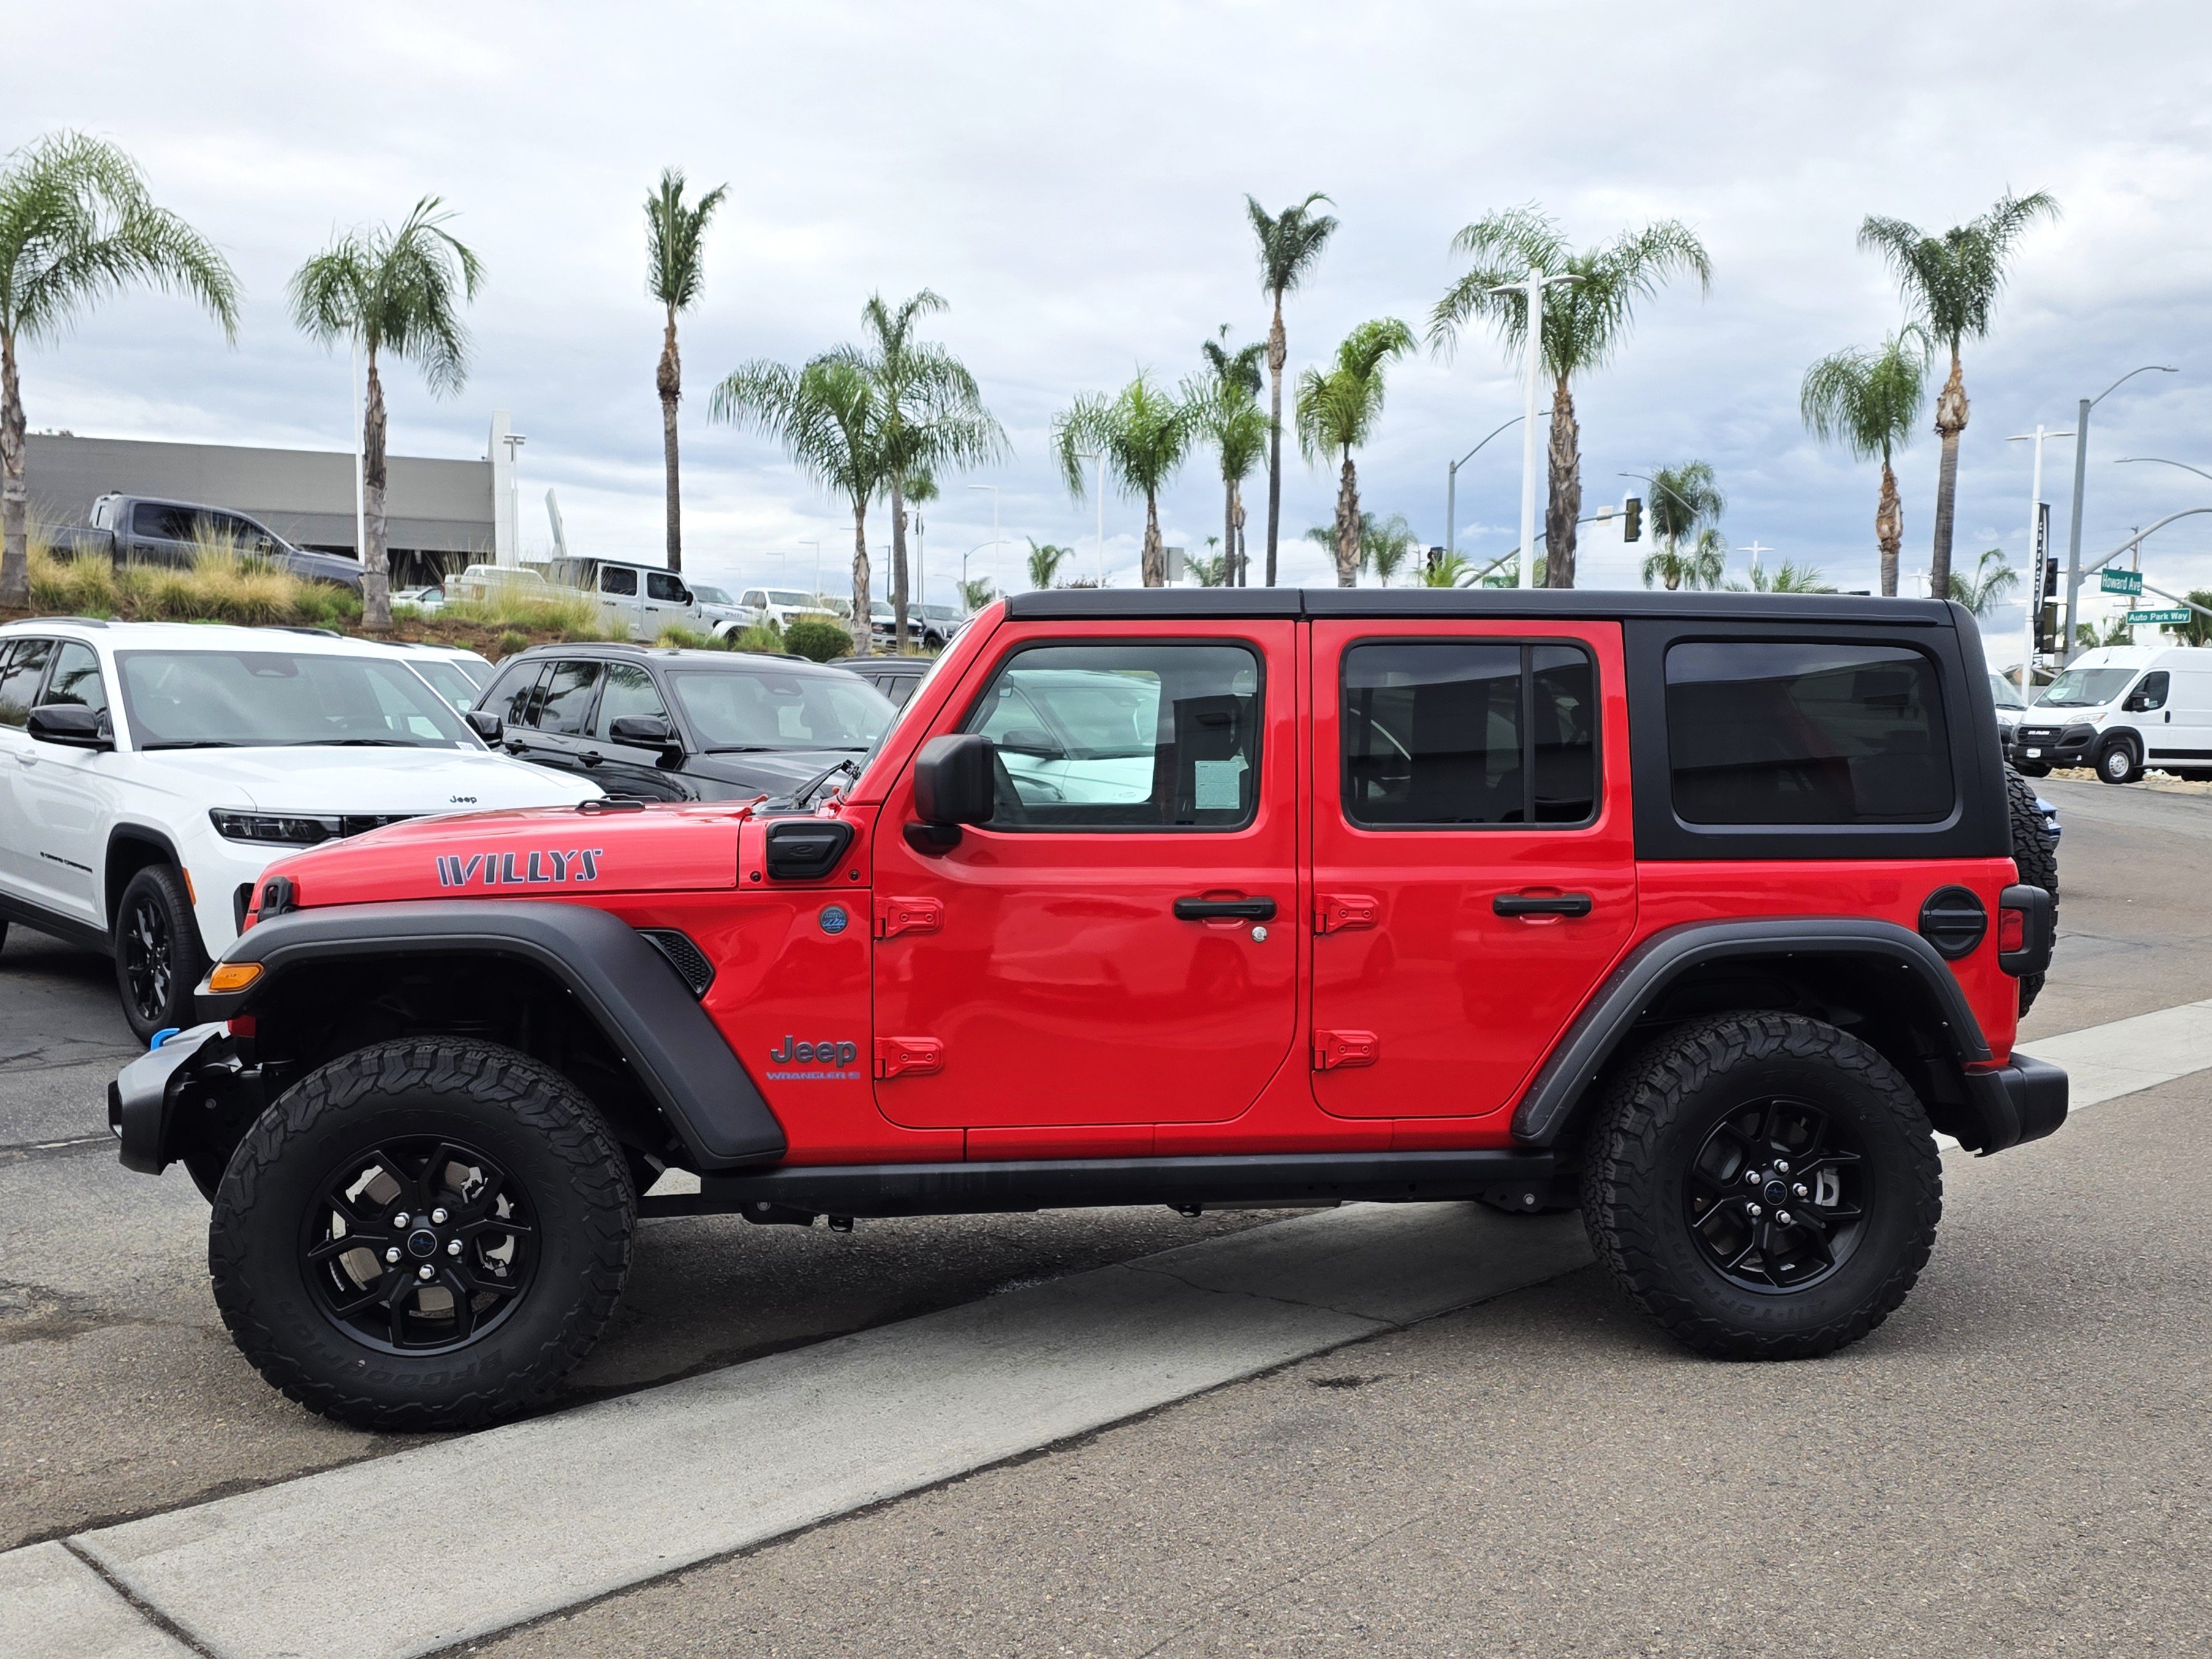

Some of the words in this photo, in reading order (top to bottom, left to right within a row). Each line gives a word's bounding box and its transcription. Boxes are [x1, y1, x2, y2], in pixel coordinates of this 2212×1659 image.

[2102, 574, 2128, 590] Howard
[2128, 577, 2141, 591] Ave
[2171, 612, 2188, 621] Way
[436, 848, 604, 887] WILLYS
[770, 1035, 857, 1068] Jeep
